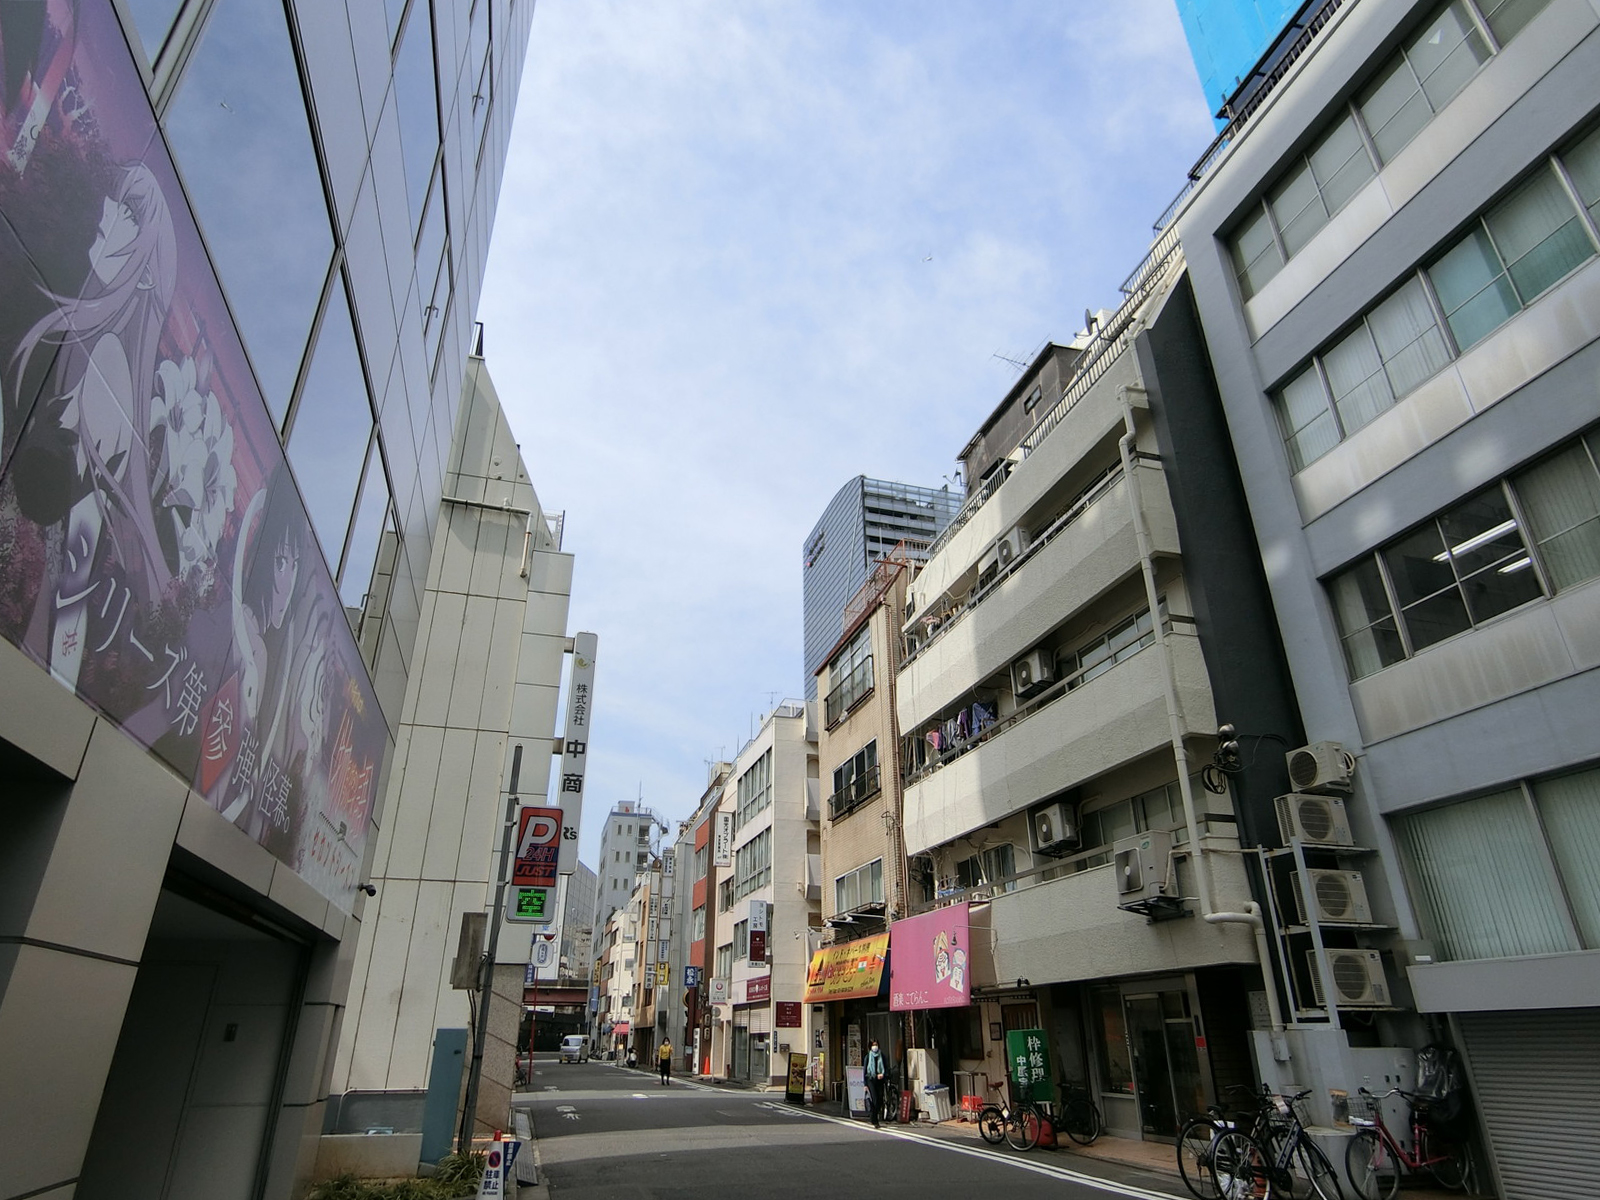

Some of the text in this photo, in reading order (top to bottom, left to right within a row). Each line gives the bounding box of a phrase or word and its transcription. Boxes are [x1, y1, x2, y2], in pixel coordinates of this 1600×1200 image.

[562, 683, 588, 793] 株式会社 中商
[517, 815, 559, 858] P
[523, 847, 555, 862] 24H
[516, 864, 555, 877] JUST
[516, 889, 546, 917] 空
[686, 967, 695, 985] 松永
